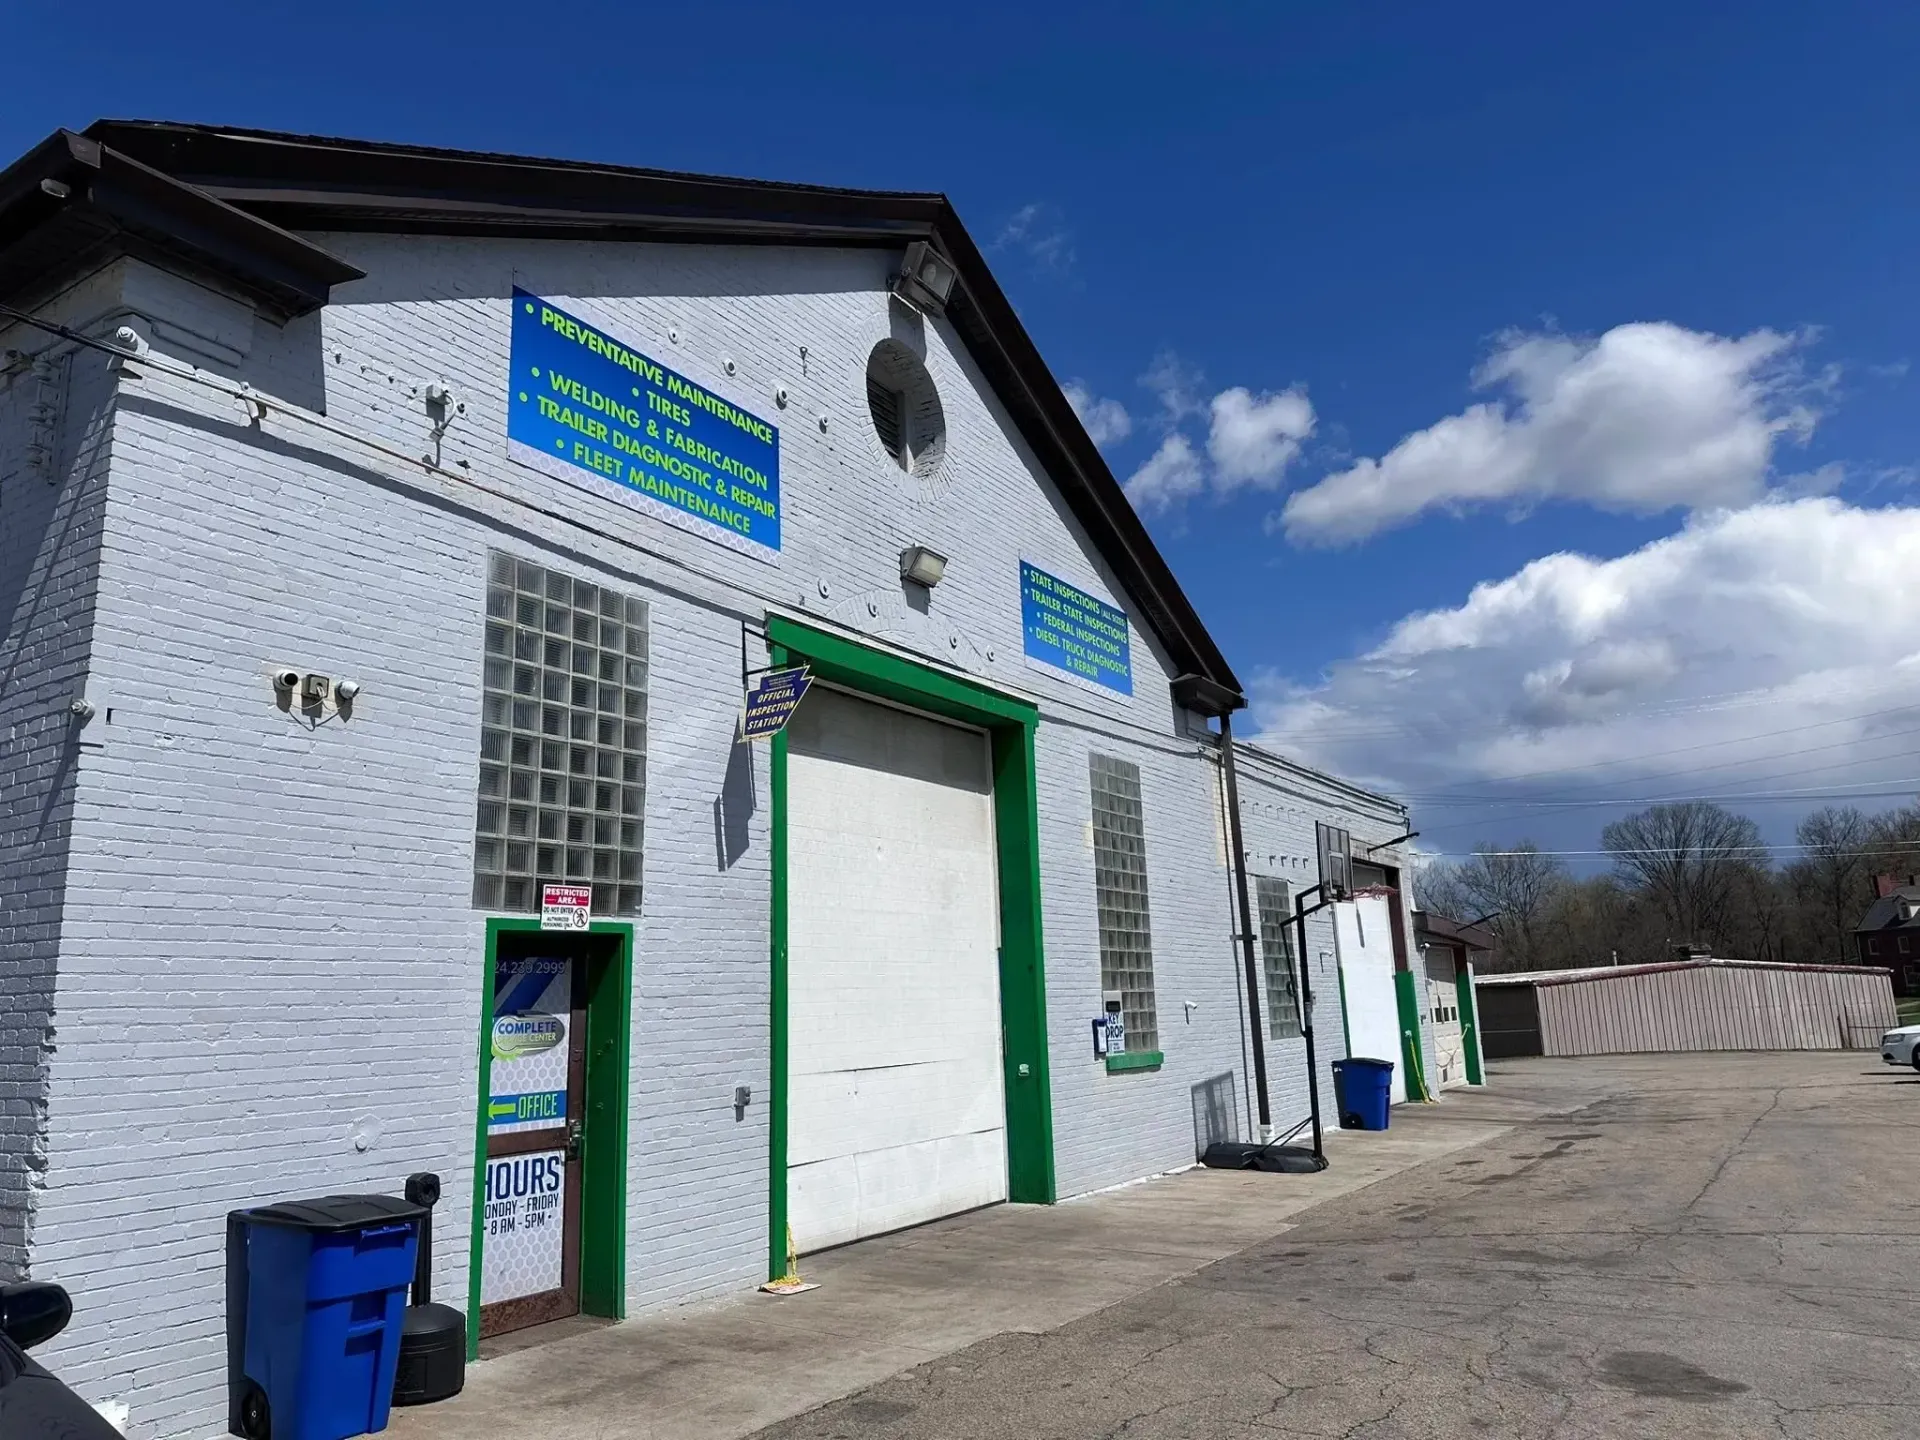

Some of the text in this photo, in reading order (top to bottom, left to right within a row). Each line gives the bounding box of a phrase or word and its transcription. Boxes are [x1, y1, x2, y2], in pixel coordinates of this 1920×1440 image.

[541, 306, 773, 445] PREVENTATIVE MAINTENANCE
[647, 390, 691, 428] TIRES
[549, 370, 768, 491] WELDING & FABRICATION
[537, 395, 777, 521] TRAILER DIAGNOSTIC & REPAIR
[574, 442, 751, 534] FLEET MAINTENANCE
[1030, 570, 1052, 590] STATE
[1054, 583, 1100, 614] INSPECTIONS
[1031, 588, 1128, 644] TRAILER STATE INSPECTIONS
[1043, 612, 1120, 656] FEDERAL INSPECTIONS
[1036, 627, 1128, 676] DIESEL TRUCK DIAGNOSTIC
[1066, 655, 1098, 678] & REPAIR
[757, 687, 795, 703] OFFICIAL
[747, 700, 796, 718] INSPECTION
[747, 715, 784, 730] STATION
[546, 888, 589, 897] RESTRICTED
[557, 896, 577, 904] AREA
[498, 1021, 557, 1035] COMPLETE
[1108, 1012, 1119, 1024] KEY
[529, 1032, 556, 1042] CENTER
[1105, 1025, 1124, 1039] DROP
[518, 1093, 558, 1119] OFFICE
[484, 1199, 518, 1220] ONDAY
[527, 1193, 559, 1213] FRIDAY
[491, 1220, 497, 1235] 8
[500, 1217, 515, 1233] AM
[524, 1211, 545, 1229] 5PM
